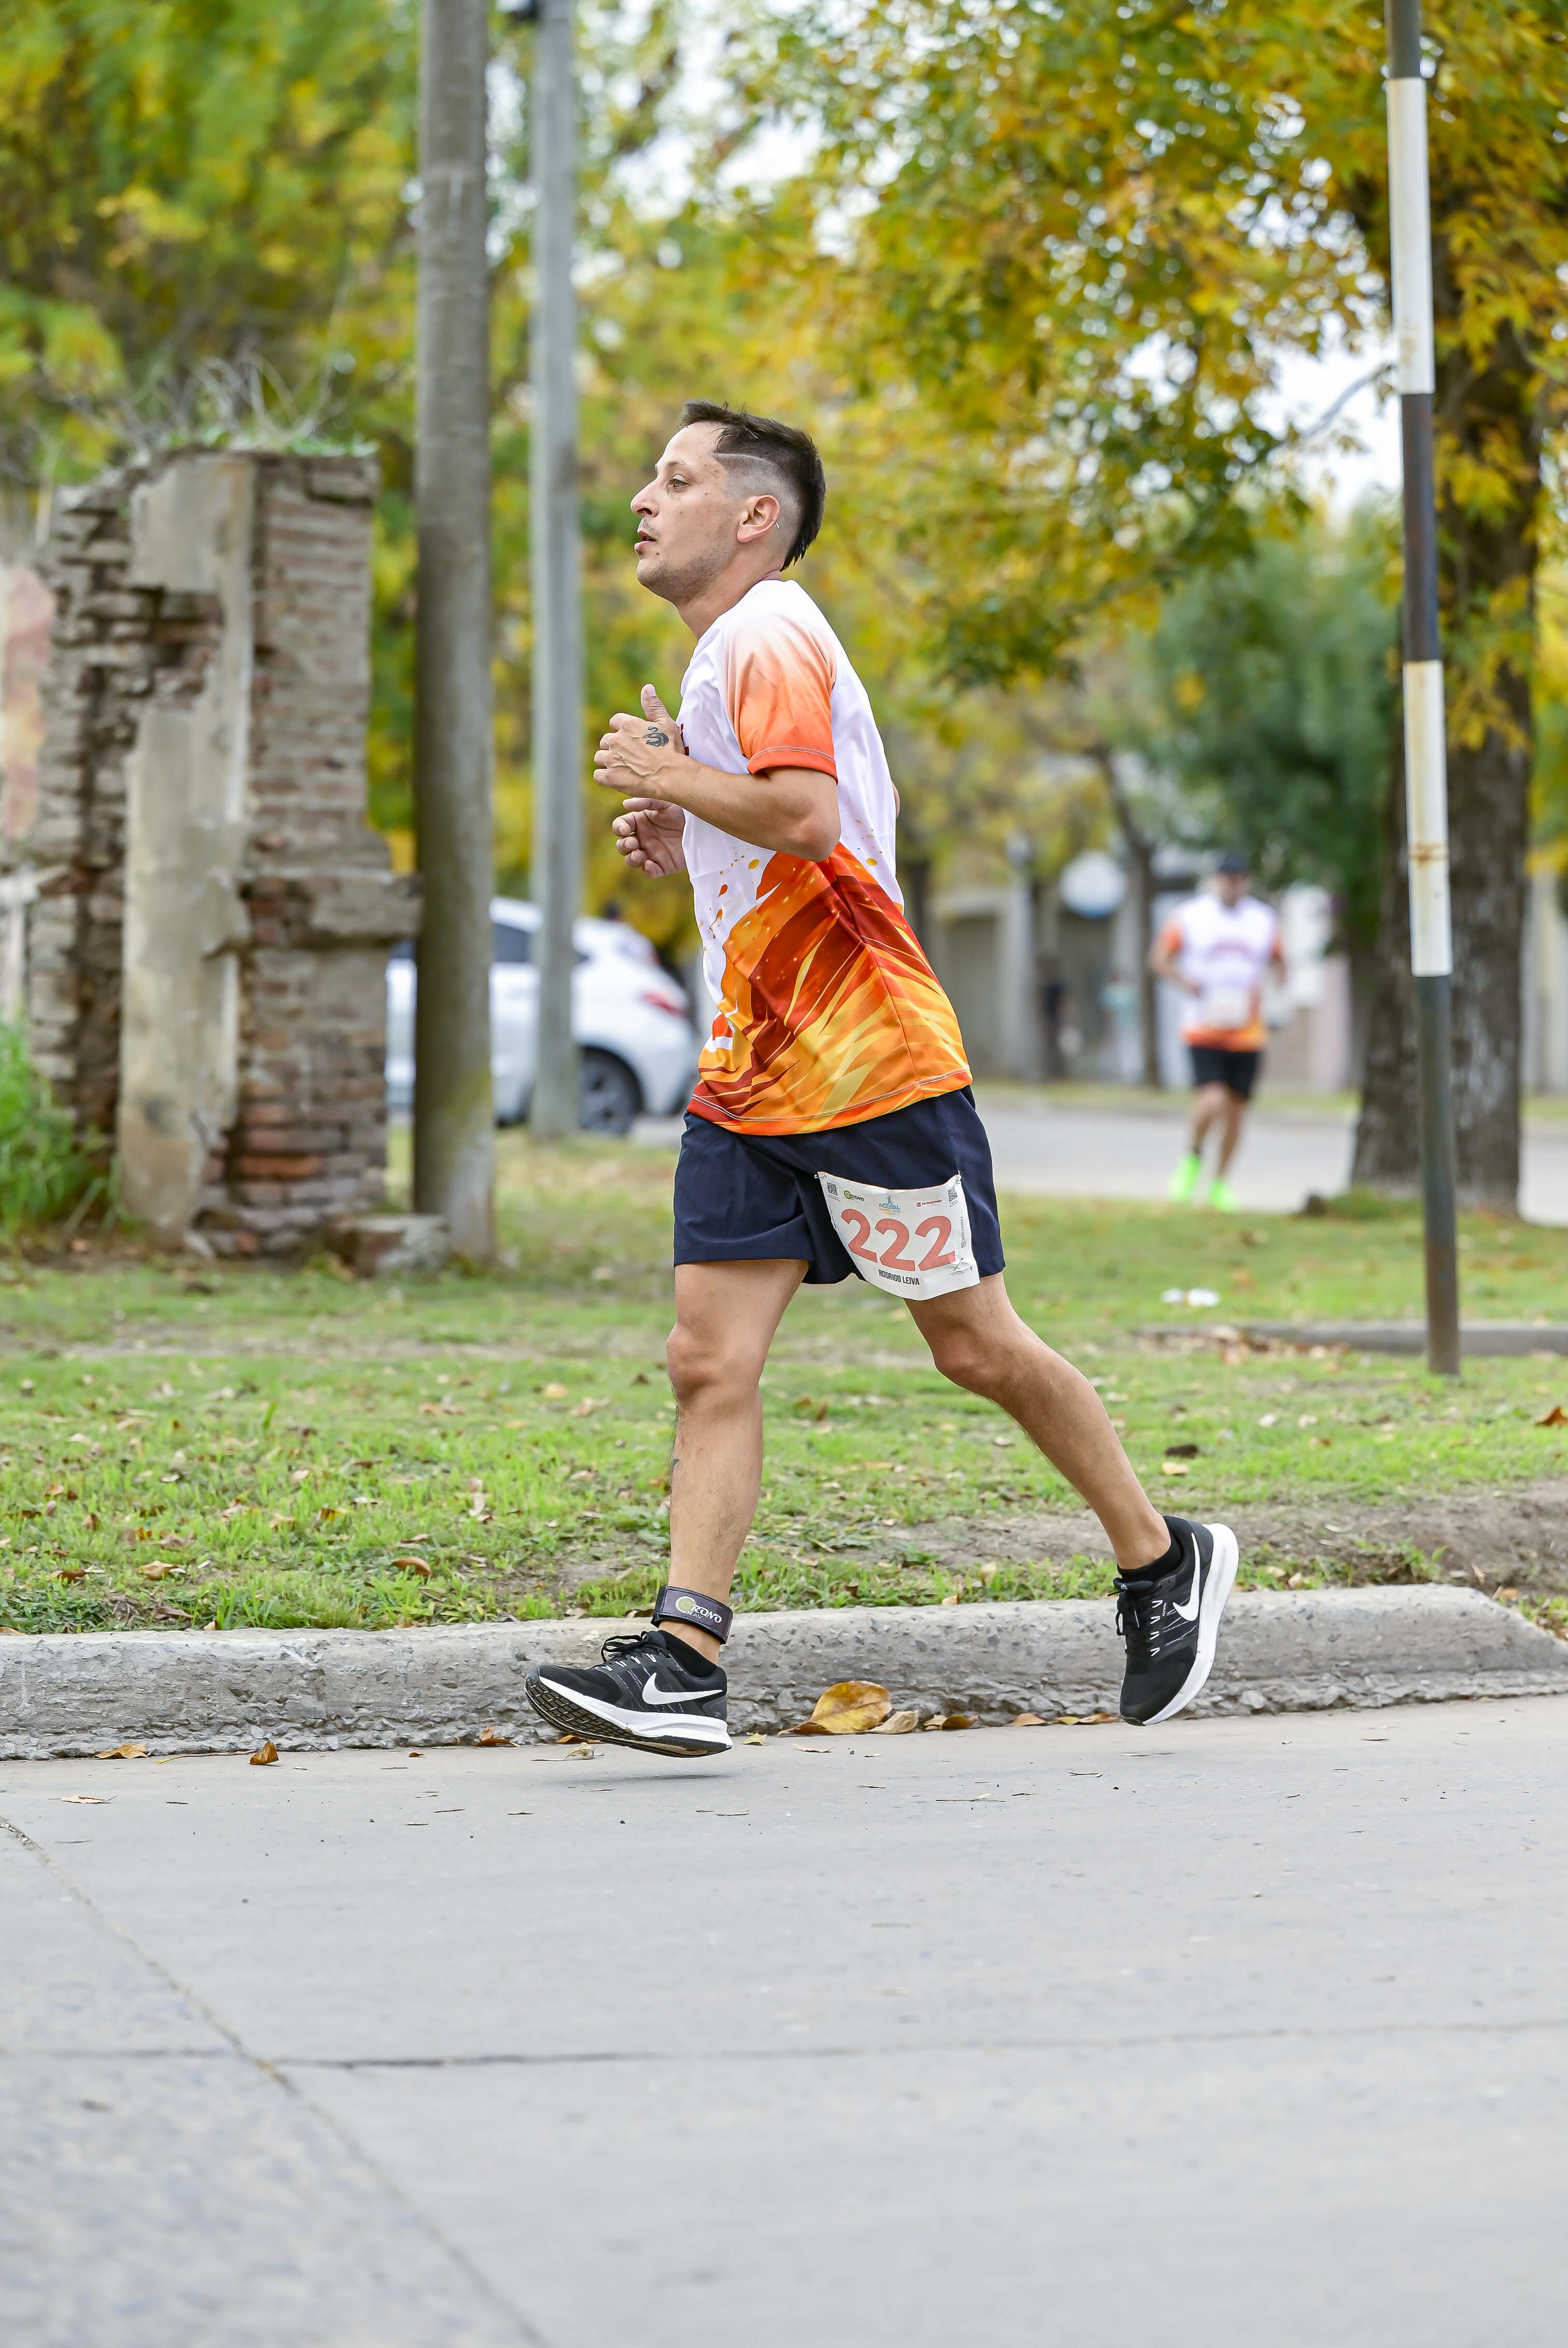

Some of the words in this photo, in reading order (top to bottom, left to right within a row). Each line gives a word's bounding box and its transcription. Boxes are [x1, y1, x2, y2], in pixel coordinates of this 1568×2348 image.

[841, 1208, 956, 1272] 222
[878, 1269, 901, 1283] RODRIGO
[902, 1276, 920, 1285] LEIVA
